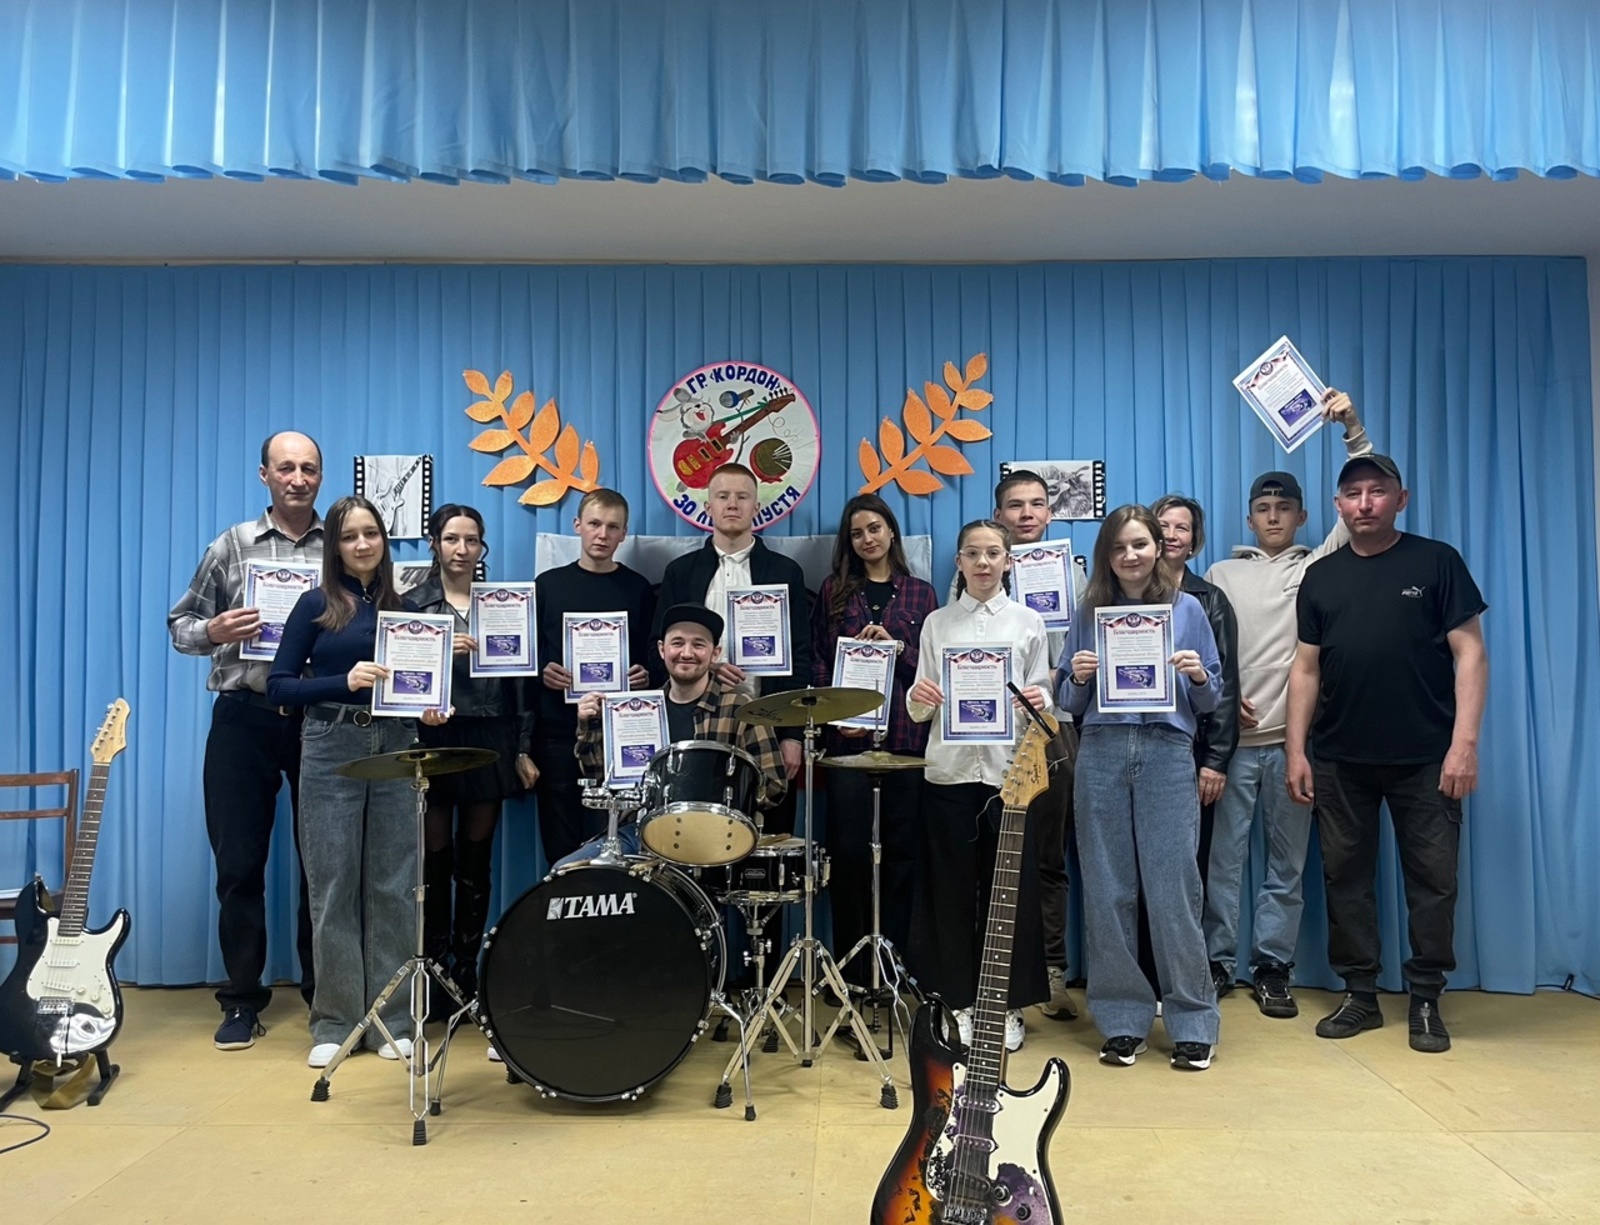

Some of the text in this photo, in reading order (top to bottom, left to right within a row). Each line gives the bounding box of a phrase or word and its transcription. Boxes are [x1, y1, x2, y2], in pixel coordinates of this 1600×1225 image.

[673, 494, 697, 516] 30
[394, 634, 437, 642] Благодарность
[1113, 628, 1156, 636] Благодарность
[563, 892, 636, 919] TAMA
